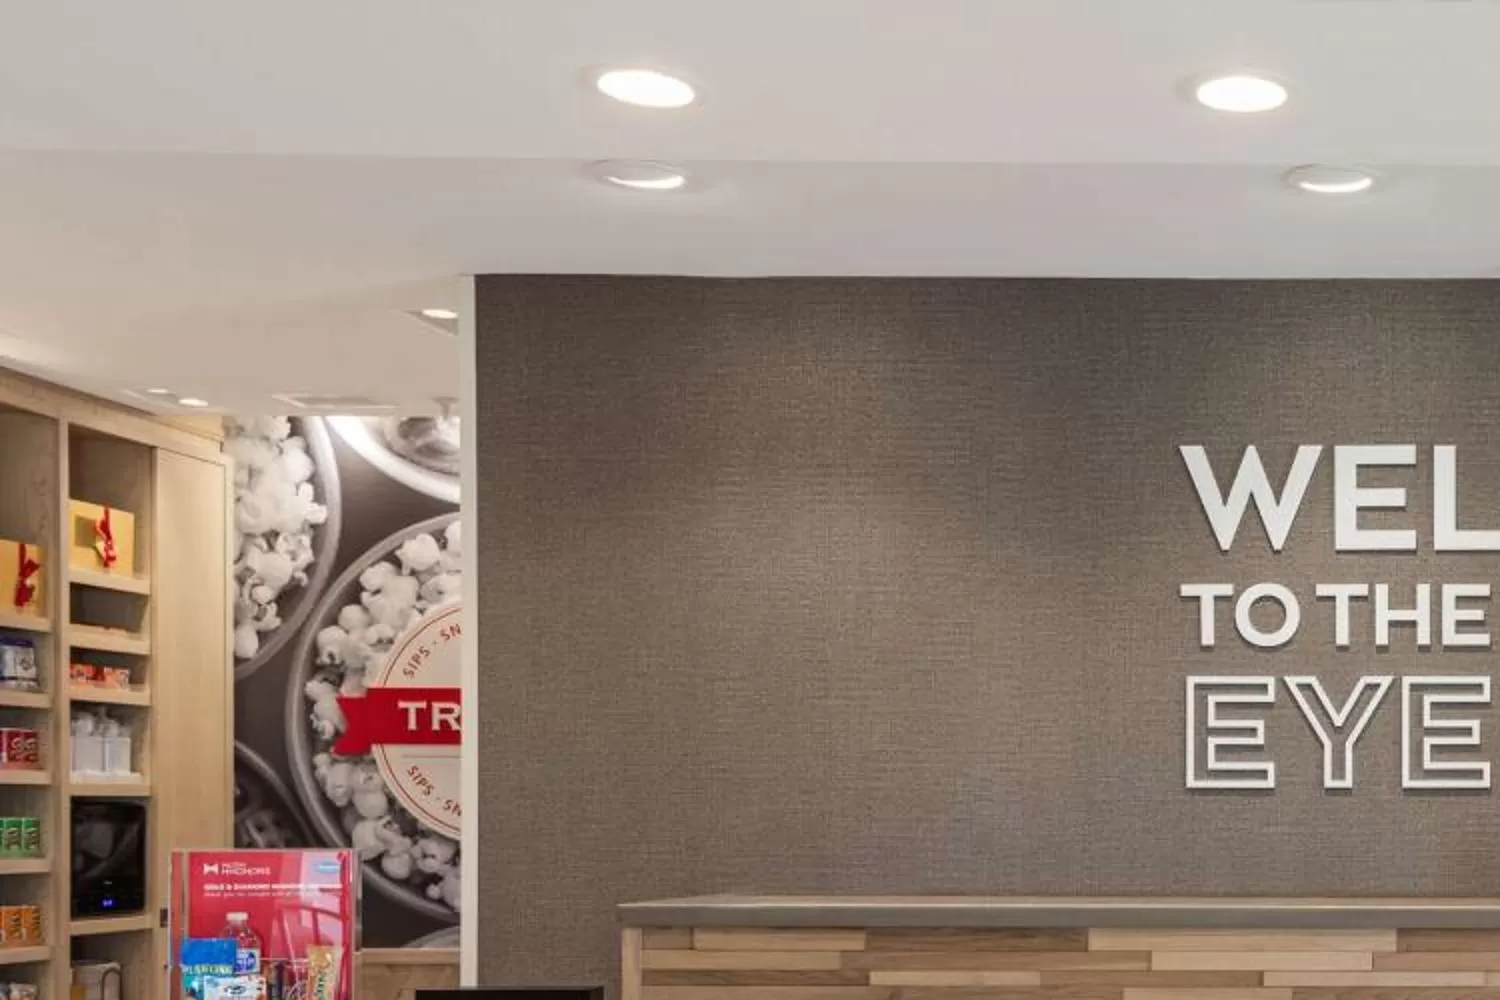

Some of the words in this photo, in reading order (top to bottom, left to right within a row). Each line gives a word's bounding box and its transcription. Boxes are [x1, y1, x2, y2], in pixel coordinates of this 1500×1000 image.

[1181, 583, 1300, 646] TO
[1316, 584, 1490, 645] THE
[403, 645, 431, 678] SIPS
[397, 700, 461, 731] TR
[1187, 675, 1490, 788] EYE
[406, 764, 435, 796] SIPS
